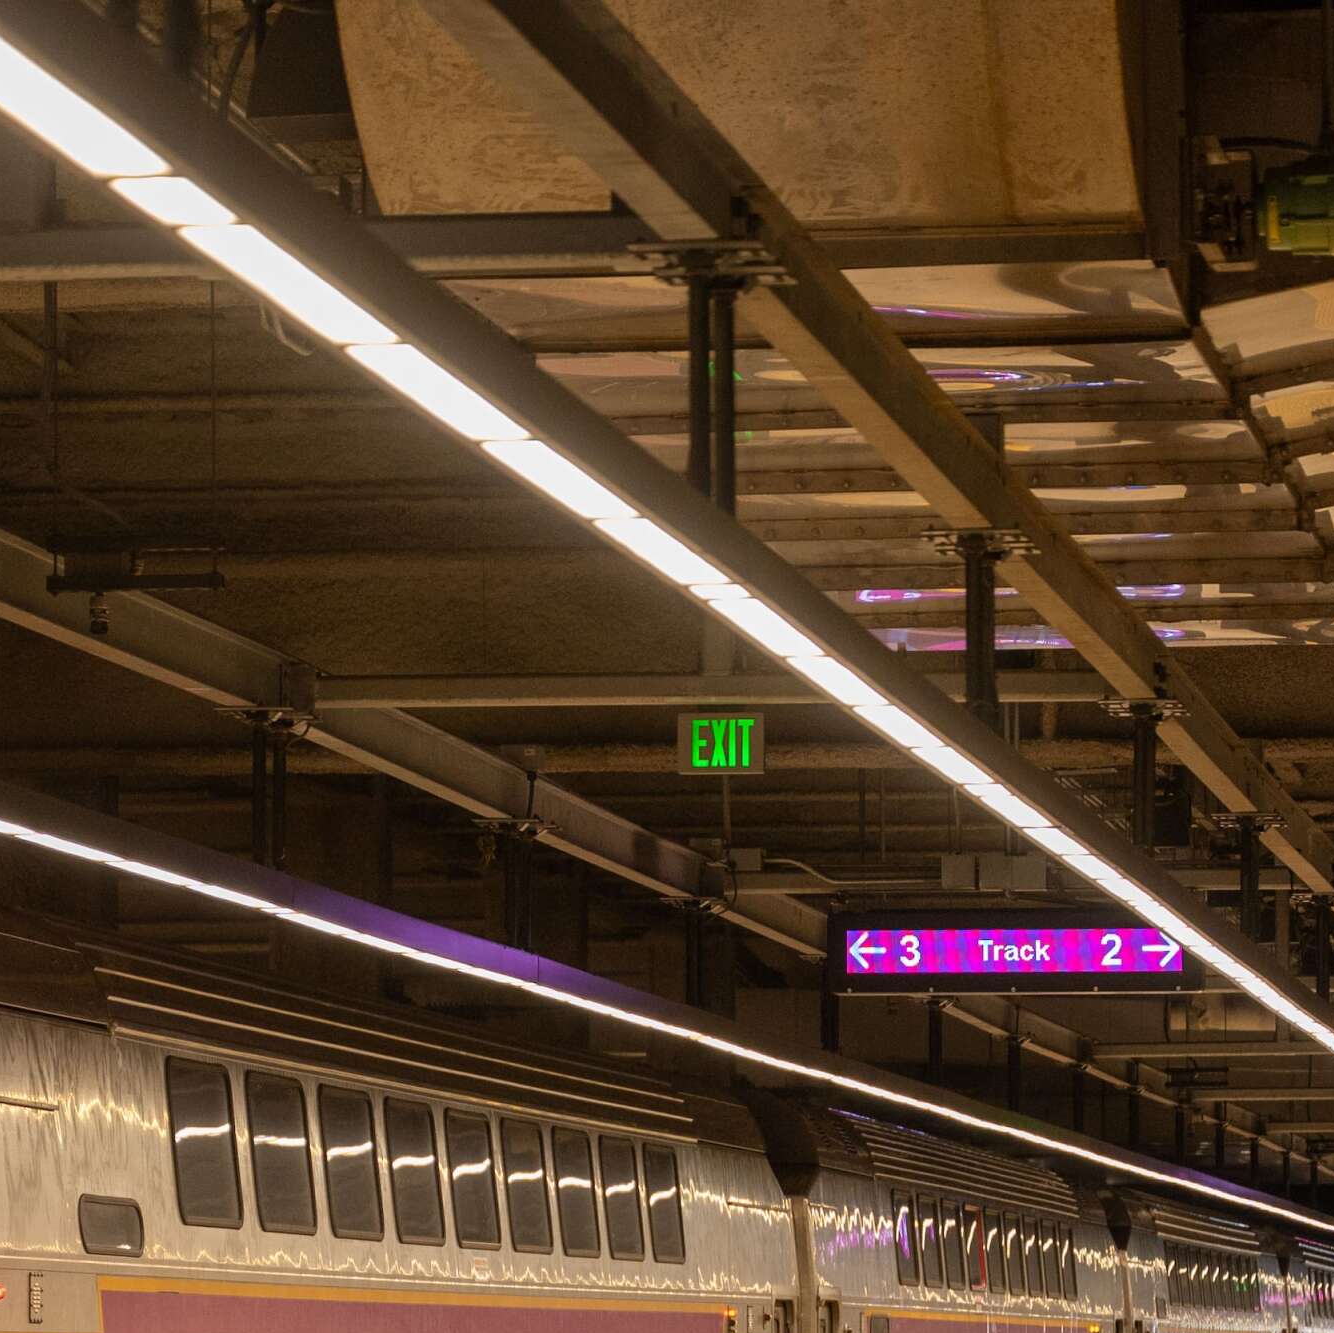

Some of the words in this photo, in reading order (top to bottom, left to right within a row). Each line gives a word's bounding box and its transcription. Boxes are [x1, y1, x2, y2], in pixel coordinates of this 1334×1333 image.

[691, 718, 754, 767] EXIT
[899, 934, 921, 967] 3
[978, 938, 1050, 962] Track
[1100, 934, 1123, 966] 2
